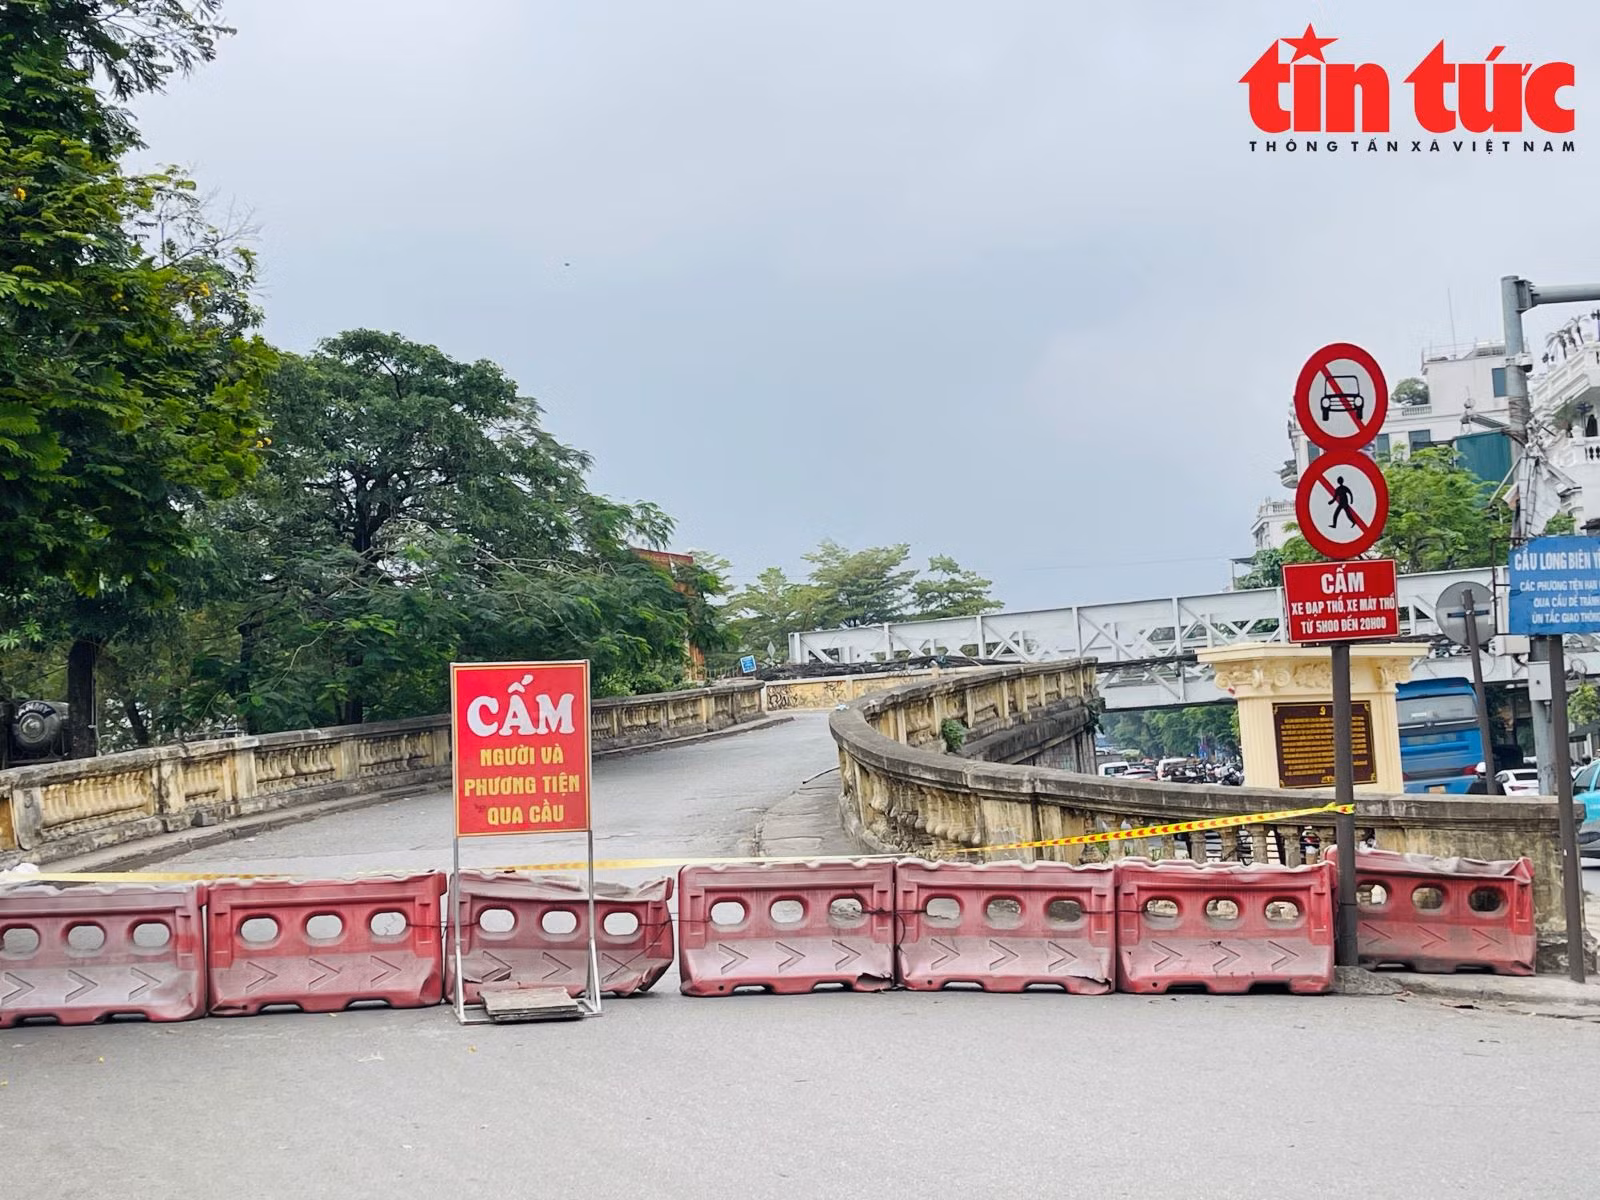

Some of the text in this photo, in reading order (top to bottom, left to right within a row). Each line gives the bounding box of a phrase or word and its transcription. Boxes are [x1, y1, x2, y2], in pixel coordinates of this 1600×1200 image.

[1540, 551, 1567, 570] LONG
[1321, 564, 1364, 594] CẤM
[1291, 602, 1304, 615] XE
[1305, 601, 1325, 617] ĐẠP
[1346, 599, 1358, 612] XE
[1359, 595, 1377, 612] MÁY
[1533, 597, 1551, 608] QUA
[1301, 618, 1314, 634] TỪ
[1316, 620, 1339, 633] 5H00
[1360, 616, 1386, 631] 20H00
[467, 674, 575, 737] CẤM
[480, 743, 564, 767] NGƯỜI VÀ
[464, 772, 580, 797] PHƯƠNG TIỆN
[487, 799, 564, 826] QUA CẦU
